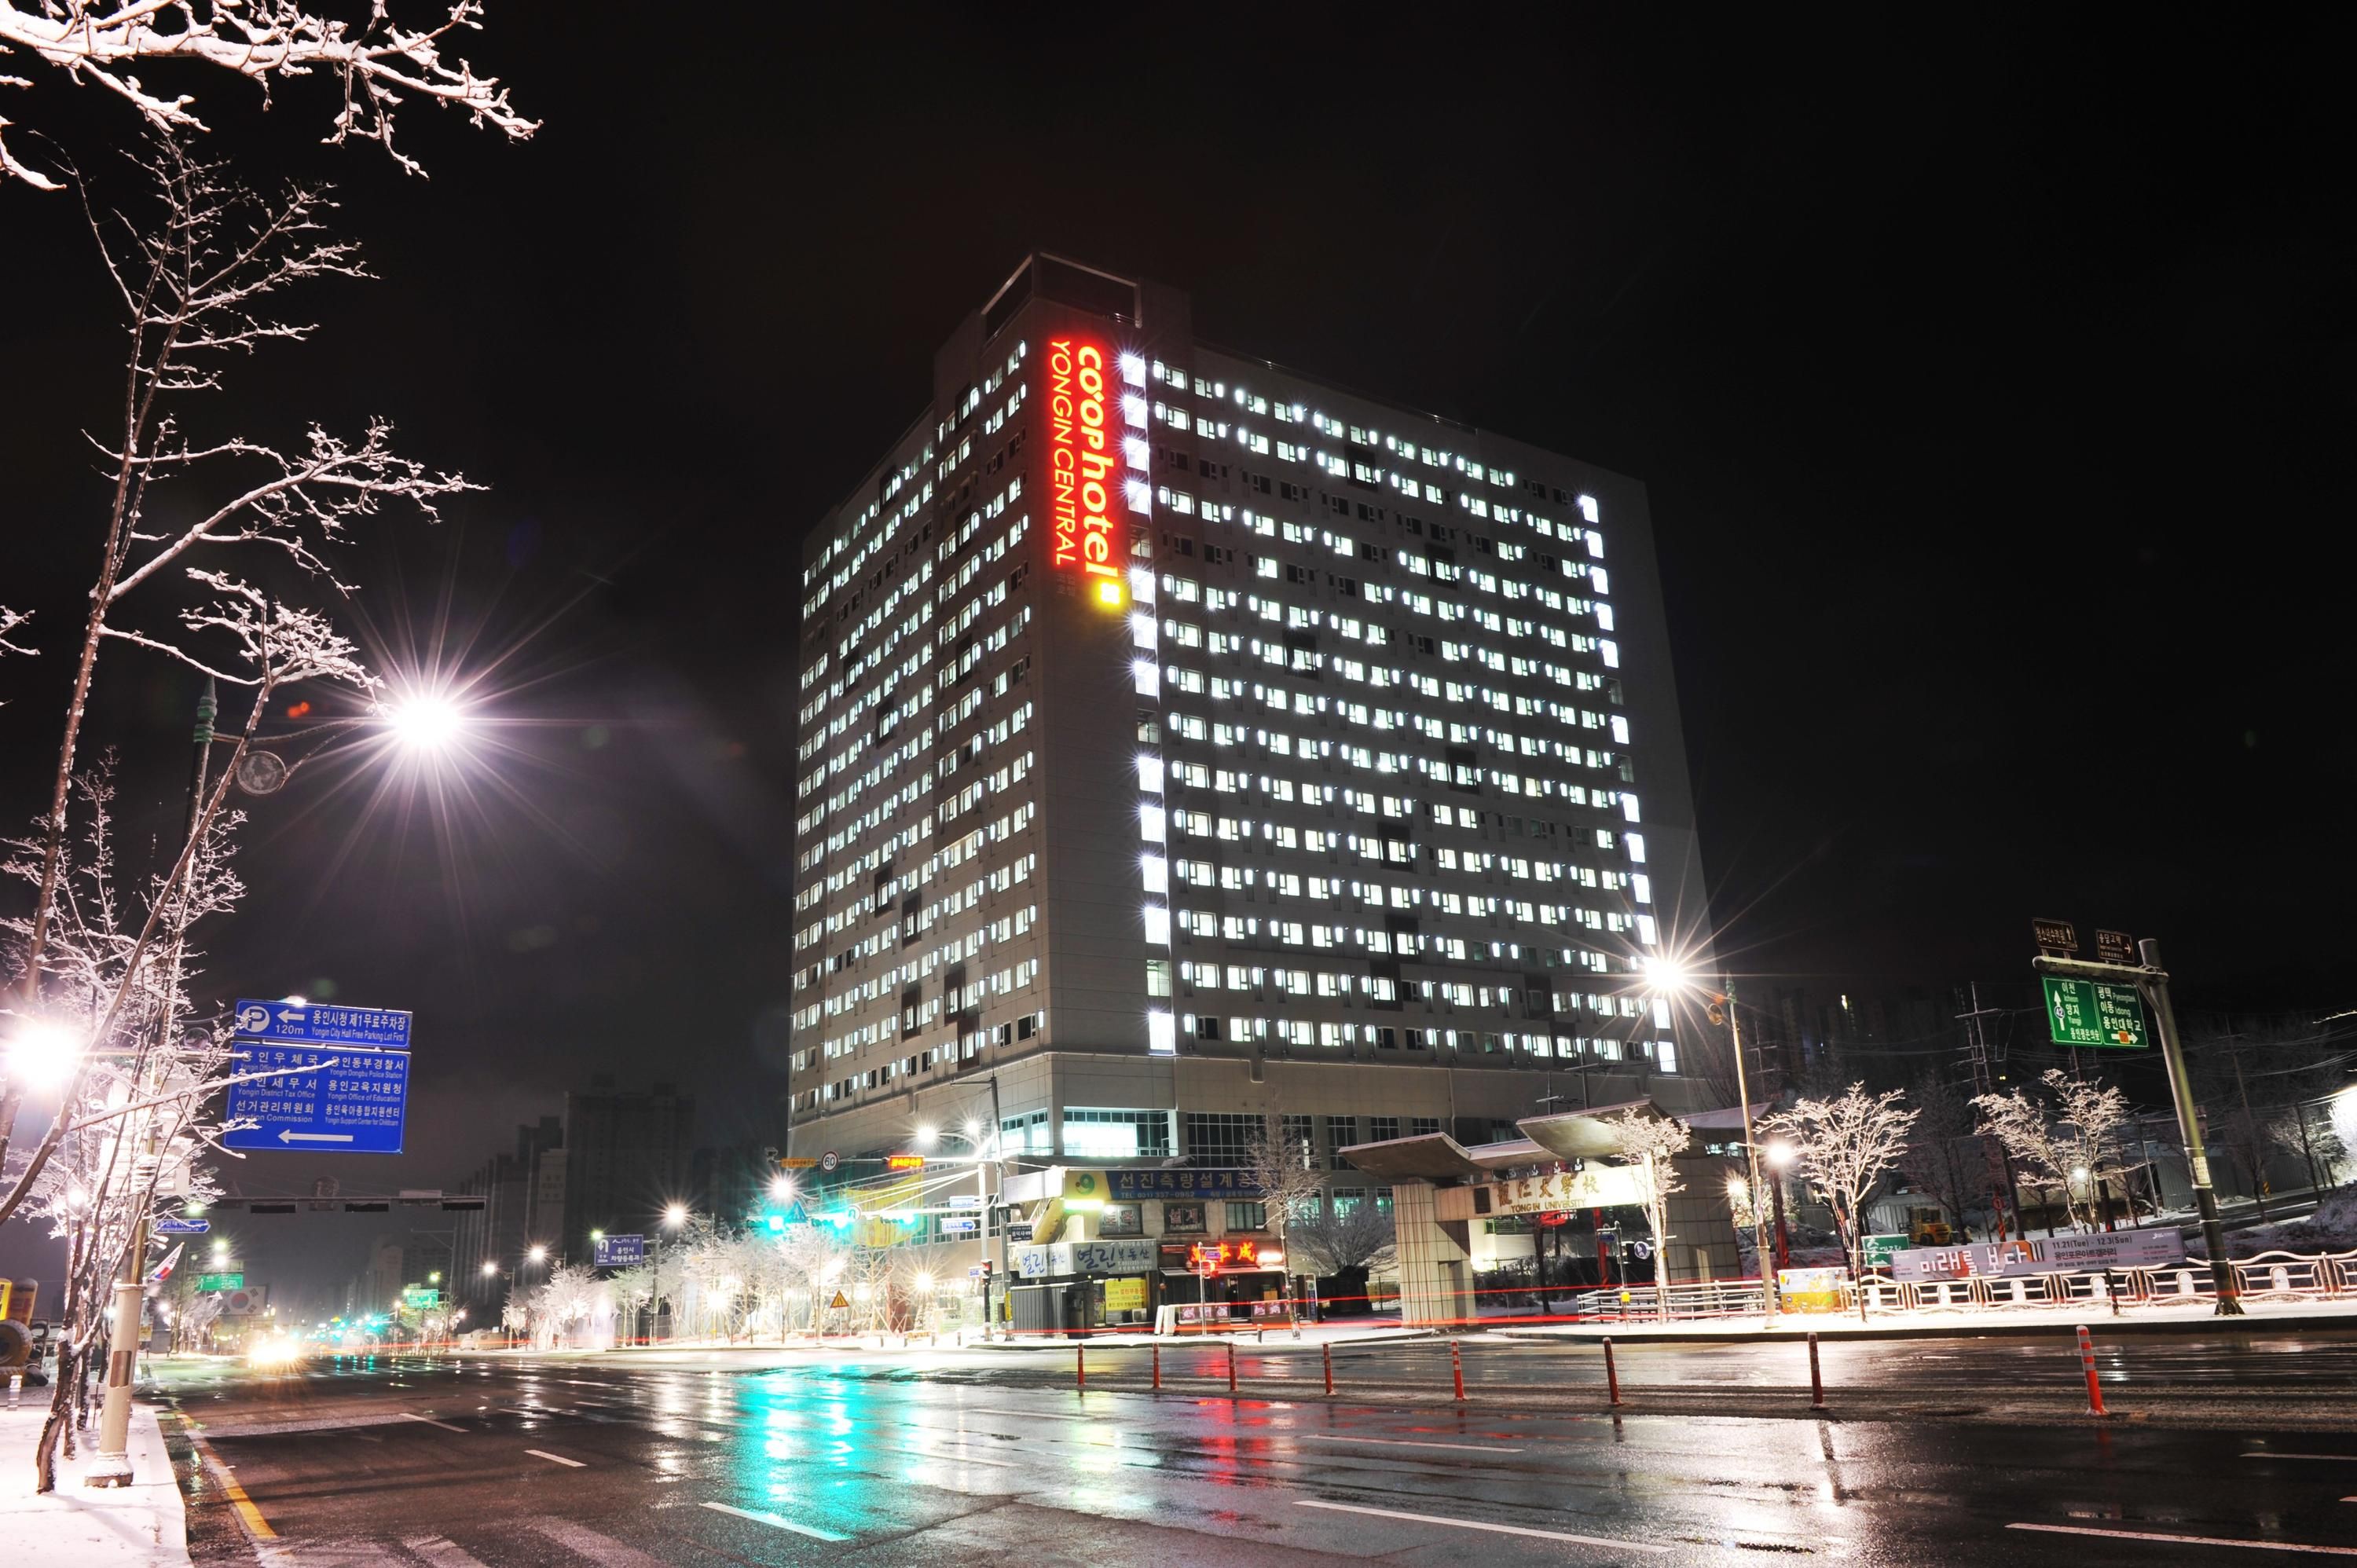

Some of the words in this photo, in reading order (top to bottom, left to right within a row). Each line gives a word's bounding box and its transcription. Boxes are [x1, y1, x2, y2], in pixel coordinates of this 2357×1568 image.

[1051, 340, 1072, 445] YONGIN
[1054, 448, 1076, 566] CENTRAL
[2062, 982, 2077, 995] 이천
[2097, 987, 2112, 1000] 평택
[2055, 1007, 2064, 1017] 42
[2066, 1004, 2080, 1016] 양지
[2100, 1002, 2114, 1013] 이동
[2115, 1006, 2132, 1017] Idong
[313, 1009, 347, 1027] 용인시청
[2103, 1017, 2143, 1031] 용인대학교
[276, 1024, 304, 1035] 120m
[312, 1026, 330, 1039] Yongin
[330, 1028, 340, 1039] City
[352, 1029, 363, 1038] Free
[364, 1030, 383, 1042] Parking
[384, 1032, 393, 1041] Lot
[394, 1032, 405, 1042] First
[242, 1050, 318, 1065] 용인우체국
[331, 1056, 404, 1071] 용인동부경찰서
[330, 1068, 347, 1078] Yongin
[348, 1069, 368, 1079] Dongbu
[368, 1070, 384, 1079] Police
[385, 1071, 403, 1079] Station
[238, 1087, 260, 1097] Yongin
[297, 1090, 315, 1099] Office
[328, 1079, 401, 1094] 용인교육지원청
[328, 1092, 347, 1101] Yongin
[236, 1100, 314, 1115] 선거관리위원회
[326, 1104, 400, 1118] 용인육아종합지원센터
[266, 1114, 313, 1123] Commission
[825, 1156, 835, 1167] 60
[1120, 1172, 1270, 1189] 선진측량설계공
[1511, 1203, 1541, 1214] YONGIN
[1545, 1199, 1586, 1211] UNIVERSITY
[2052, 1236, 2089, 1249] 11.21(Tue)
[2097, 1235, 2132, 1247] 12.3(Sun)
[1021, 1249, 1045, 1274] 열린
[1077, 1244, 1116, 1269] 열린
[1118, 1248, 1150, 1261] 부동산
[1920, 1250, 1979, 1277] 미래를
[1986, 1244, 2027, 1274] 보다
